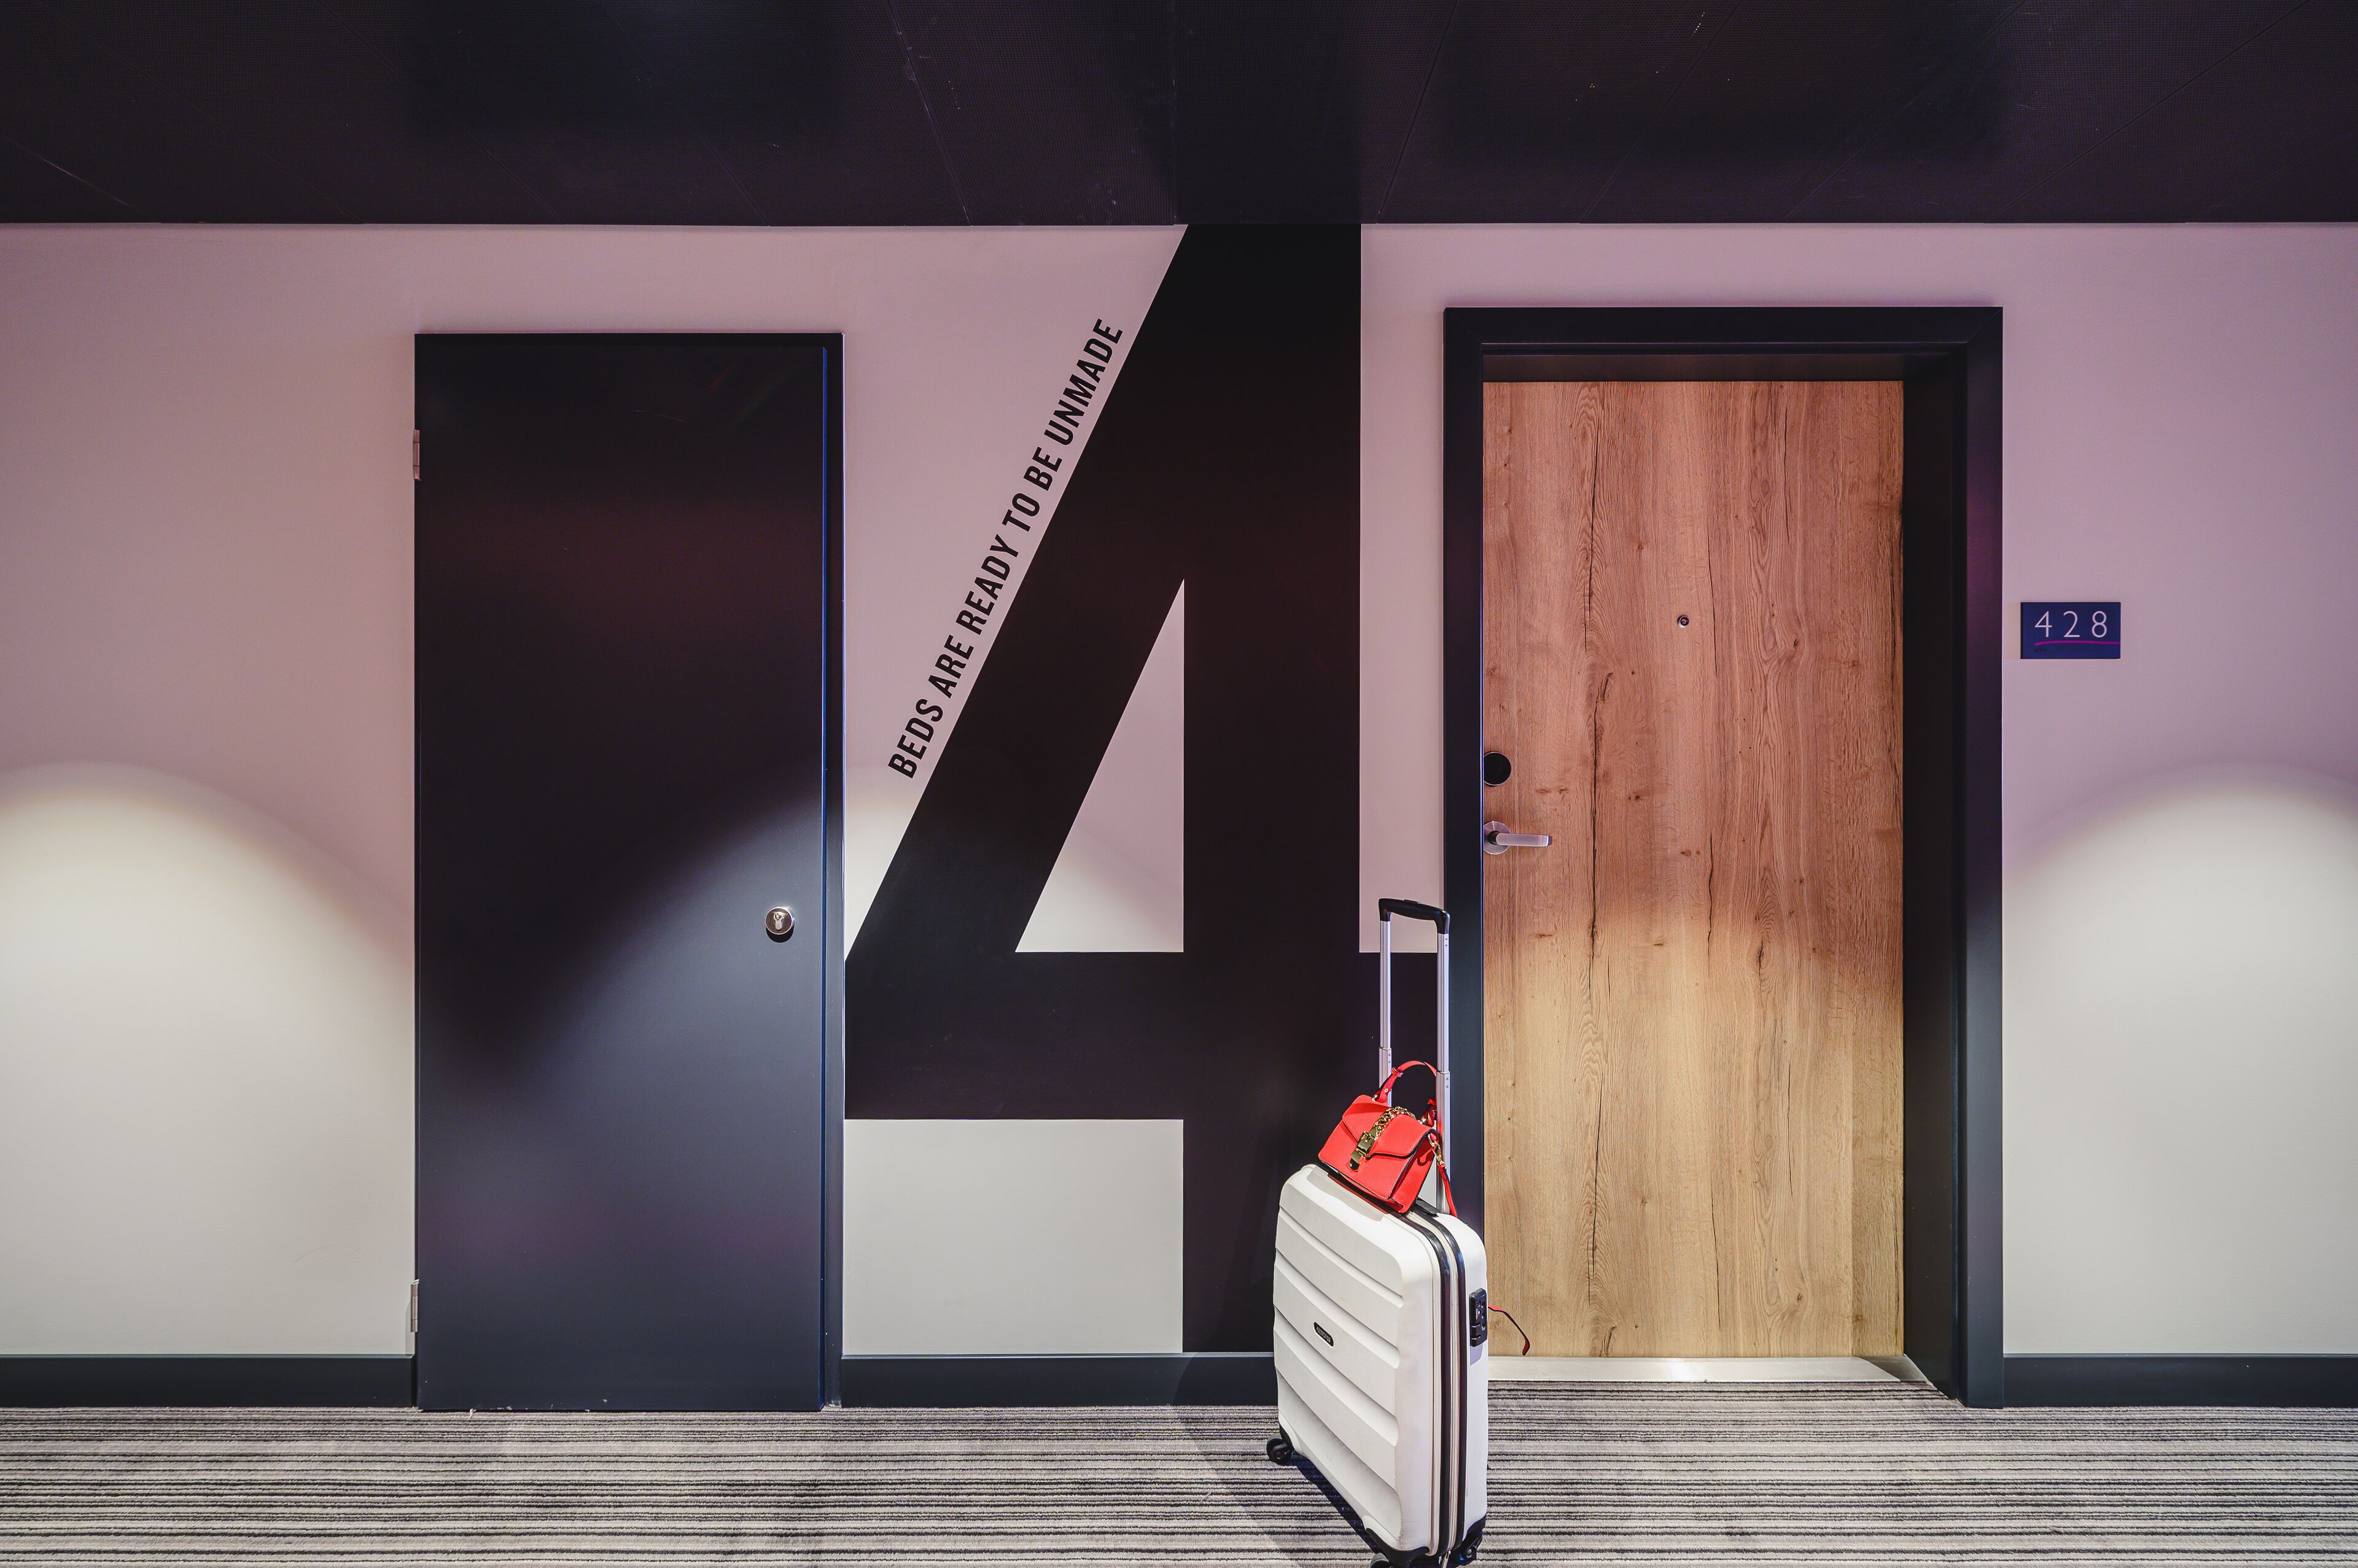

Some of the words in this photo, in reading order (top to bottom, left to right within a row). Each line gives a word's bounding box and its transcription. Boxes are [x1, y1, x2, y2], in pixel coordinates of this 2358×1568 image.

[888, 699, 943, 778] BEDS
[928, 635, 975, 698] ARE
[955, 534, 1019, 635] READY
[1002, 493, 1040, 532] TO
[1024, 447, 1063, 491] BE
[1044, 319, 1123, 445] UNMADE
[2034, 610, 2107, 638] 428
[844, 224, 1443, 1352] 4
